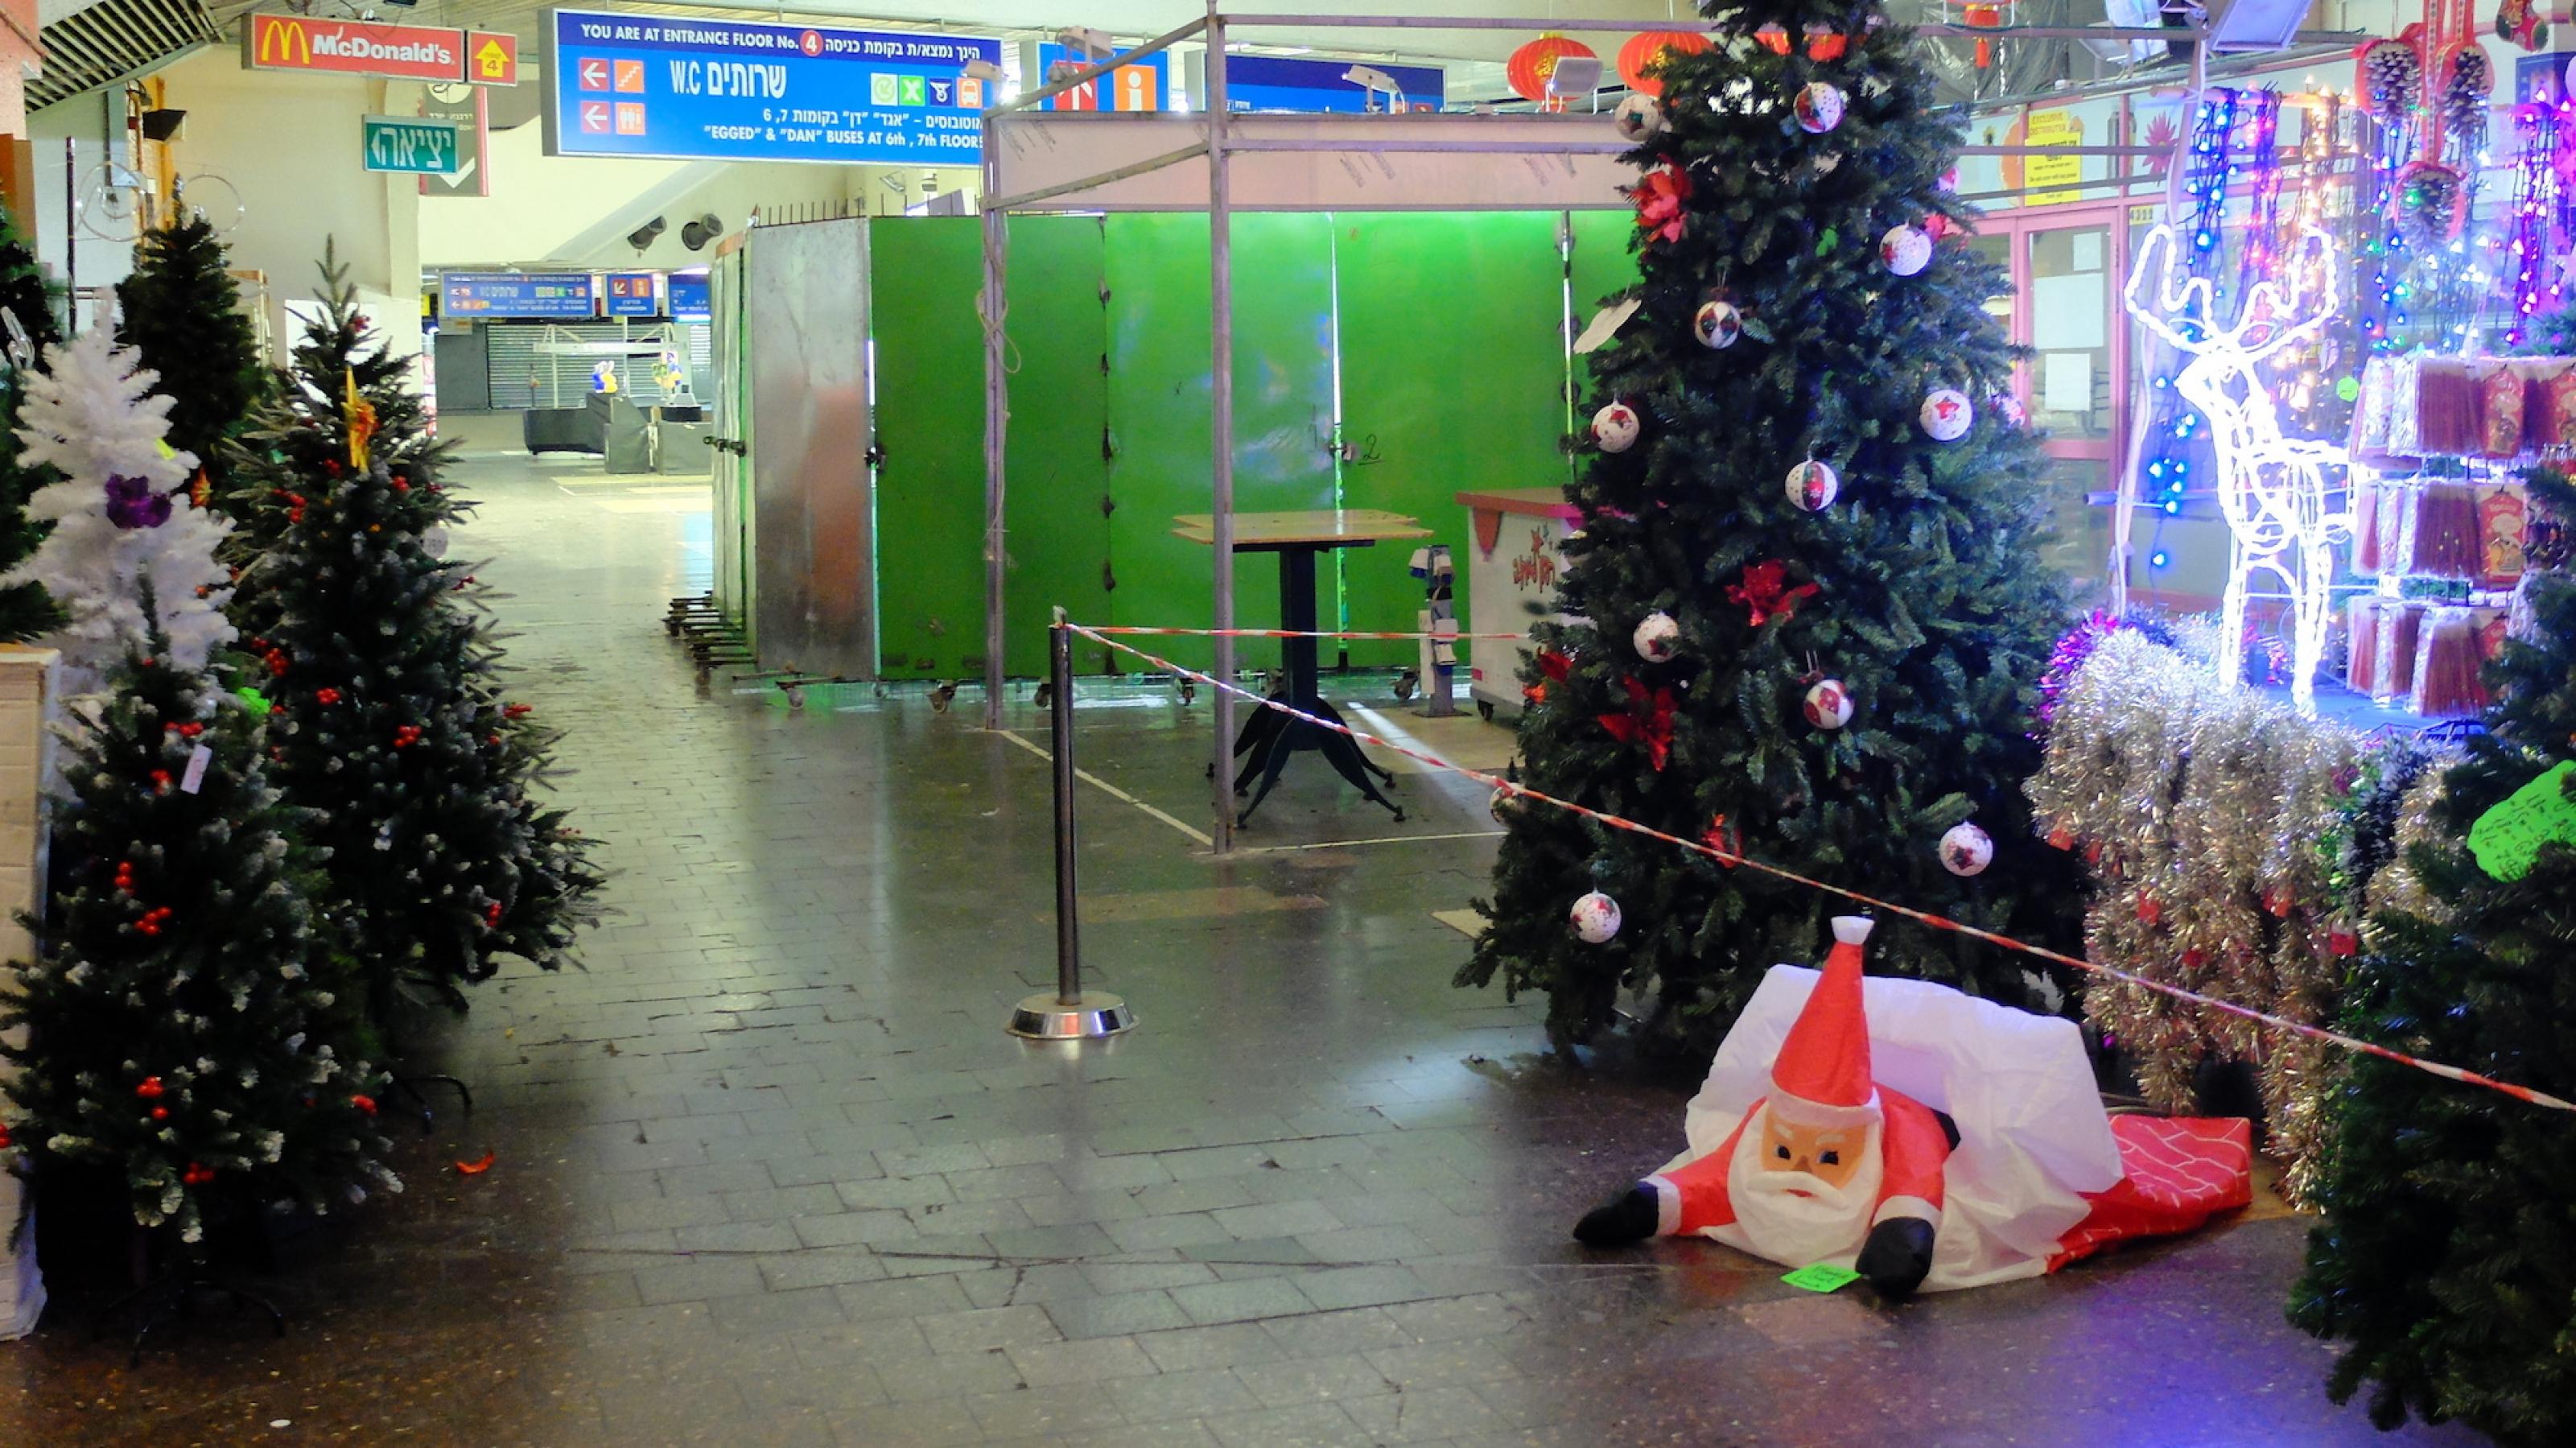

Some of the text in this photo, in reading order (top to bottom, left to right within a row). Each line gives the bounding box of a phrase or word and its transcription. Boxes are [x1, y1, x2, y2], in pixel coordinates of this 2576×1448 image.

[580, 23, 817, 52] YOU ARE AT ENTRANCE FLOOR No. 4
[825, 38, 981, 62] הינך נמצא/ת בקומת כניסה
[486, 60, 497, 71] 4
[669, 60, 787, 99] שרותים W.C
[763, 108, 772, 122] 6
[792, 109, 839, 127] בקומות
[381, 127, 451, 168] יציאה
[703, 125, 762, 140] "EGGED"
[765, 127, 776, 142] &
[780, 128, 822, 142] "DAN"
[826, 130, 864, 144] BUSES
[868, 131, 883, 145] AT
[885, 132, 906, 146] 6th
[917, 133, 938, 146] 7th
[1362, 433, 1382, 460] 2
